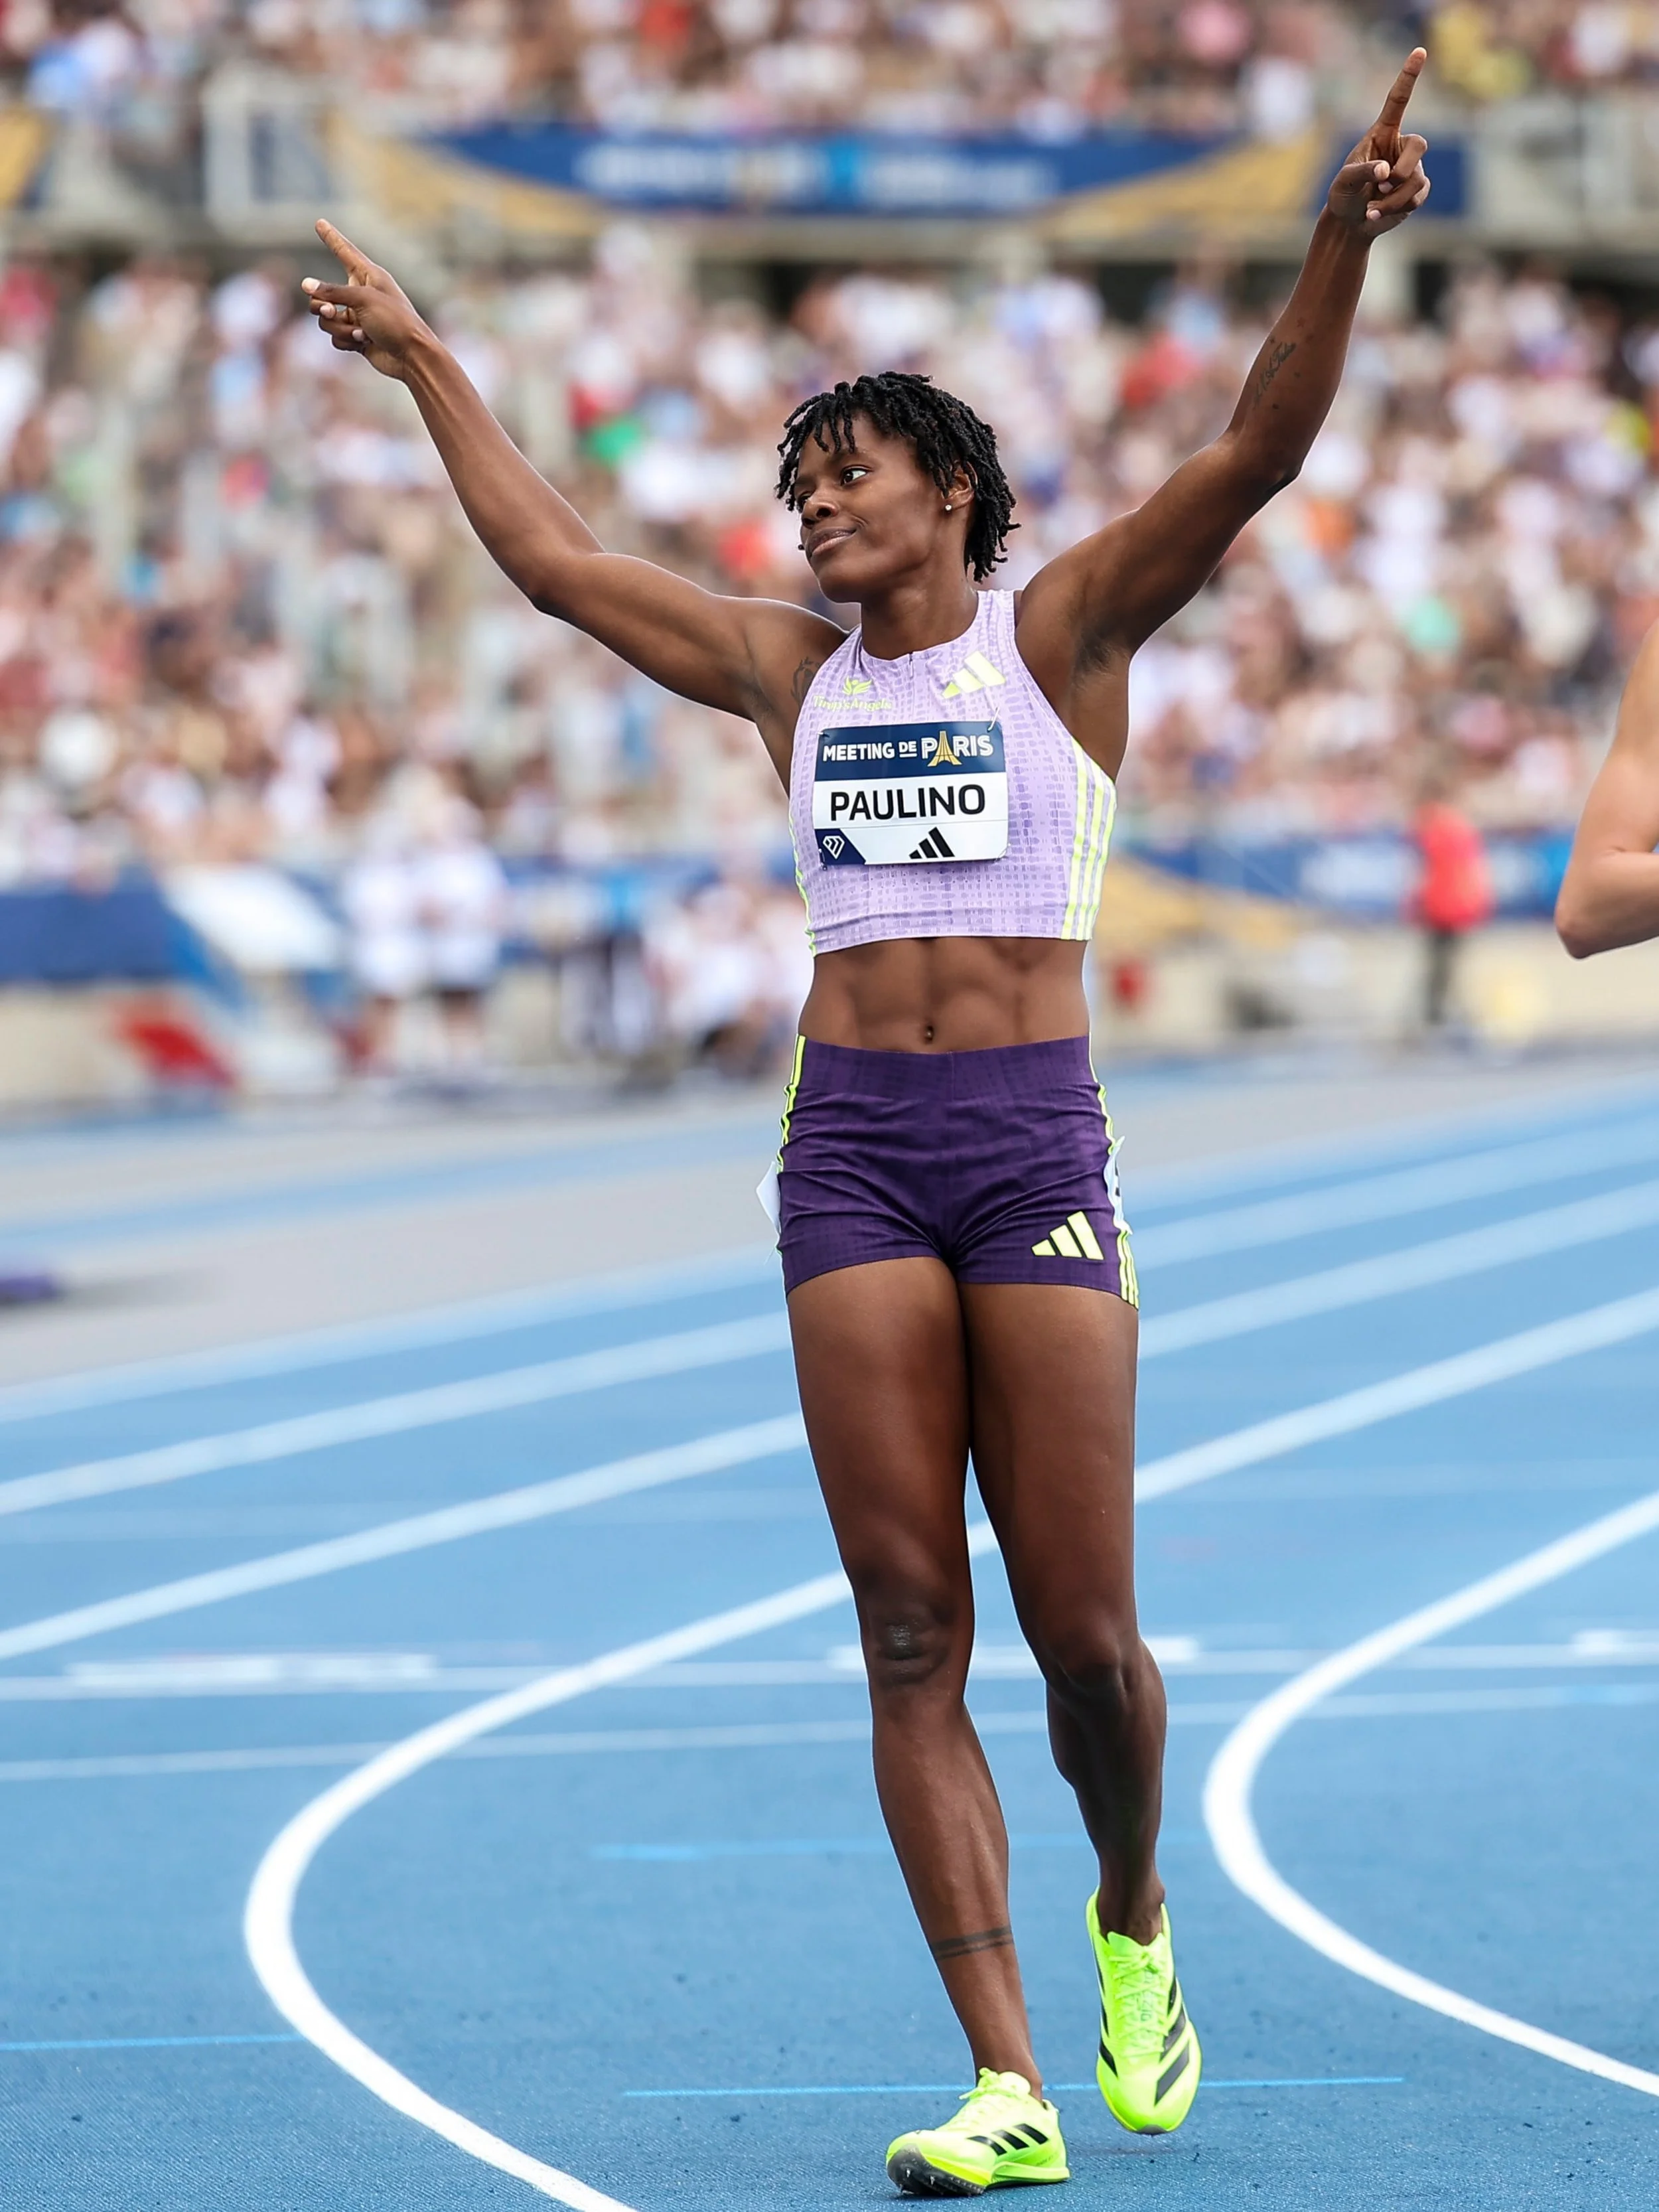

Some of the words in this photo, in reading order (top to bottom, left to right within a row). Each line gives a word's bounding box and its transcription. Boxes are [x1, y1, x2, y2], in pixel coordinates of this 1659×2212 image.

[822, 742, 895, 761] MEETING
[899, 740, 917, 755] DE
[920, 731, 994, 767] PARIS
[830, 784, 985, 821] PAULINO
